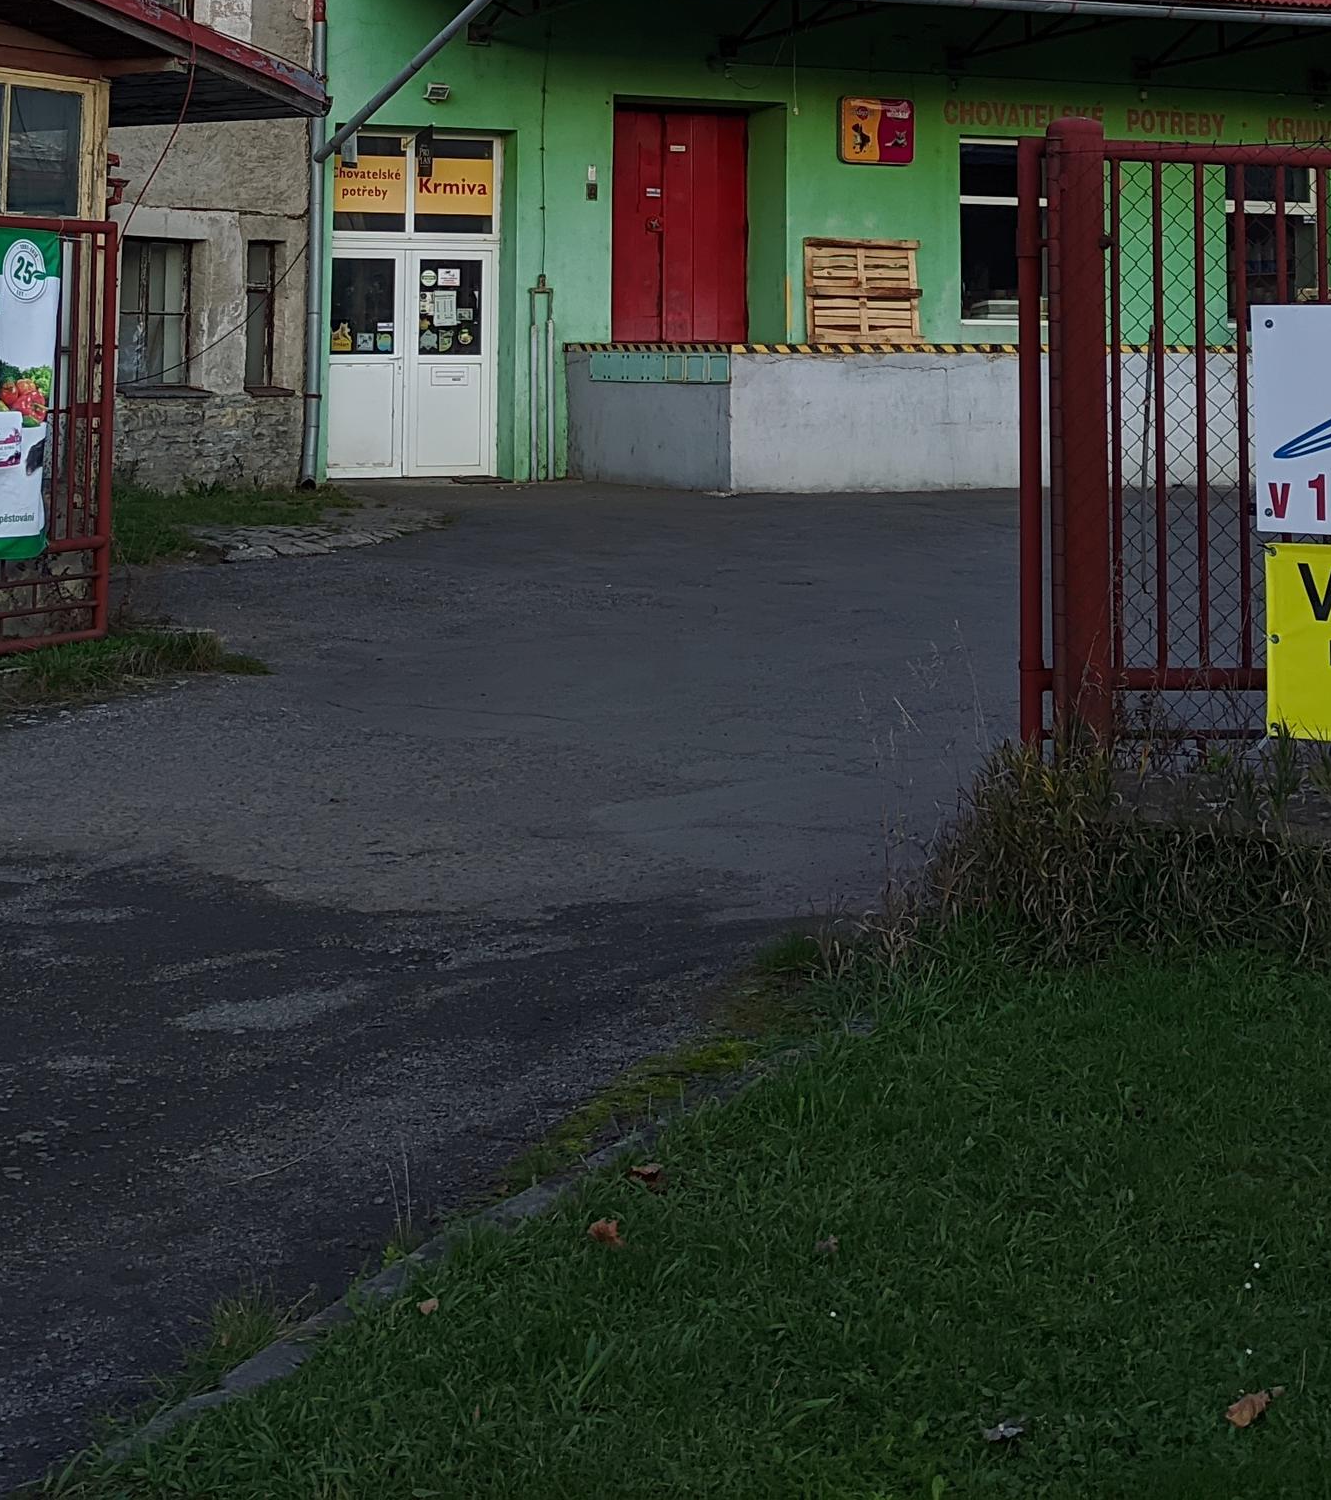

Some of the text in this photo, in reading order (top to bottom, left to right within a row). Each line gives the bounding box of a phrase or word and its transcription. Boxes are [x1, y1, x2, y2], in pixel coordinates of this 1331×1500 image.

[1126, 104, 1227, 138] POTŘEBY
[333, 167, 401, 181] Chovatelské
[341, 186, 389, 201] potřeby
[418, 177, 488, 196] Krmiva
[13, 255, 34, 285] 25
[1268, 481, 1293, 521] v
